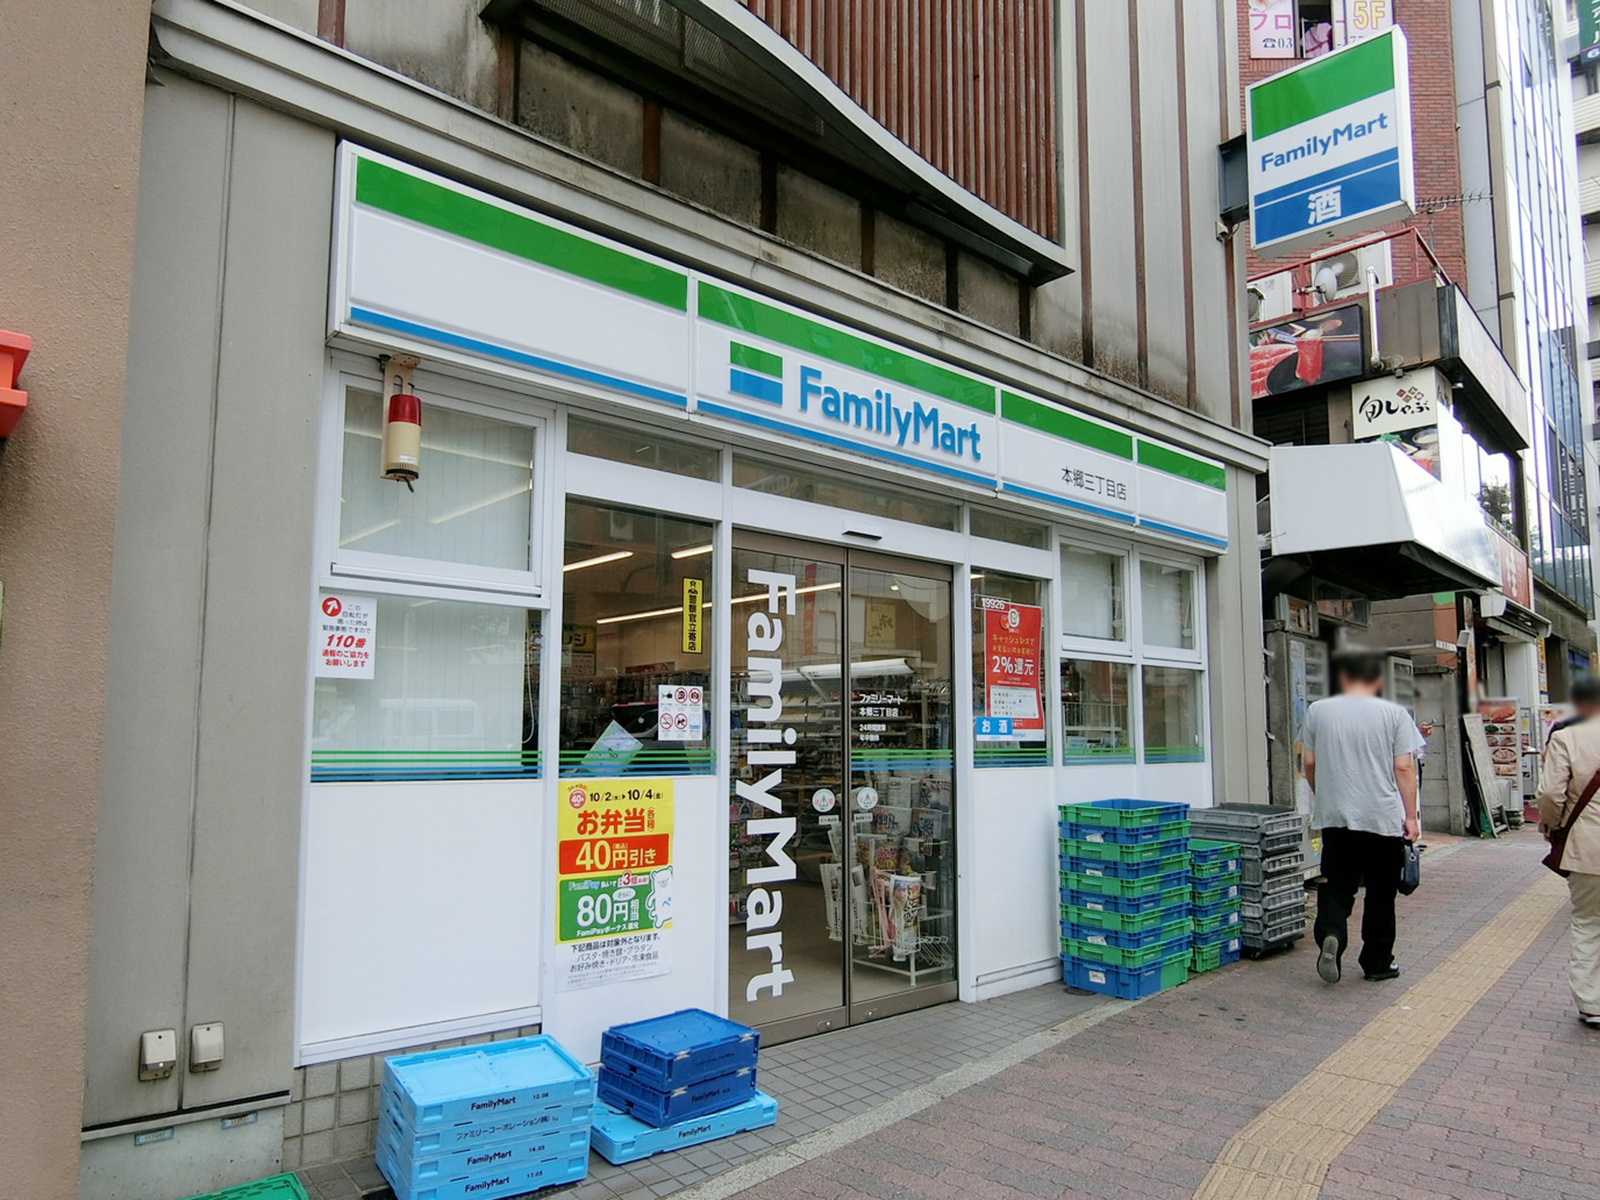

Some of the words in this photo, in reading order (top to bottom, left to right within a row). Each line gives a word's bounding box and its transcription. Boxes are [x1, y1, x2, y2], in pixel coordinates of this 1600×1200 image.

[1353, 1, 1385, 30] 5F
[1261, 112, 1388, 172] FamilyMart
[1307, 185, 1342, 225] 酒
[800, 364, 981, 461] FamilyMart
[1359, 395, 1430, 422] 旬しゃぶ
[1061, 466, 1127, 501] 本郷三丁目店
[688, 594, 698, 651] 警察官立寄店
[327, 634, 366, 648] 110番
[992, 634, 1034, 646] キャッシュレスで
[325, 658, 366, 668] お願いします
[992, 655, 1034, 675] 2%還元
[859, 693, 904, 705] ファミリーマート
[859, 706, 899, 717] 本郷三丁目店
[735, 569, 797, 1003] FamilyMart
[577, 807, 645, 836] お弁当
[575, 840, 657, 871] 40円引き
[470, 1096, 516, 1111] FamilyMart
[678, 1125, 711, 1138] FamilyMart
[466, 1150, 512, 1165] FamilyMart
[464, 1177, 510, 1192] FamilyMart
